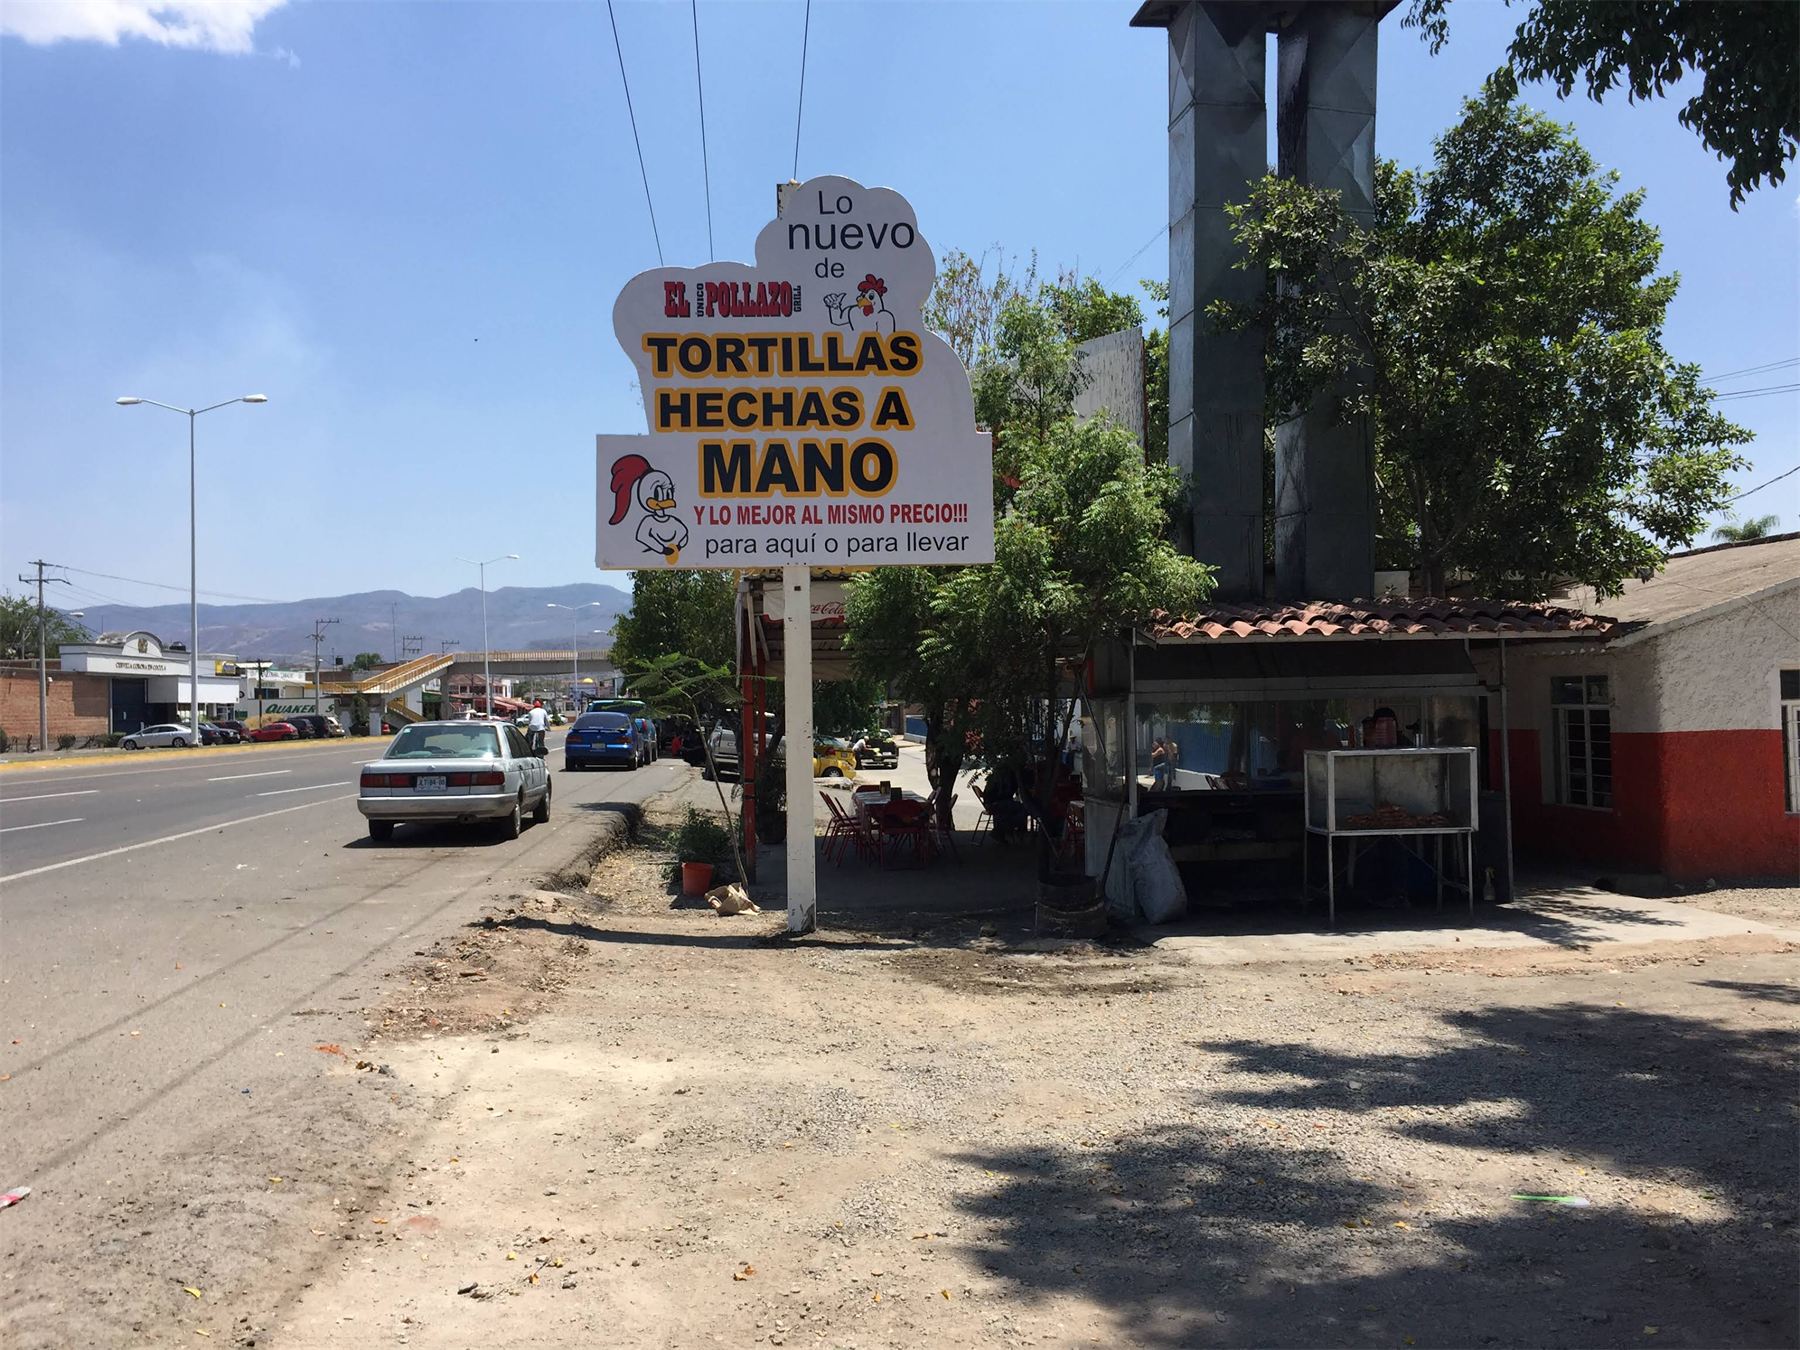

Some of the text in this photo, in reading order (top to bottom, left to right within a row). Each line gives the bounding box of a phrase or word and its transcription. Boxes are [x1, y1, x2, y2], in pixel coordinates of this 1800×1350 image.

[818, 191, 853, 215] Lo
[788, 222, 915, 250] nuevo
[815, 258, 845, 278] de
[664, 281, 691, 317] EL
[705, 281, 793, 318] POLLAZO
[645, 335, 920, 373] TORTILLAS
[658, 390, 910, 428] HECHAS A
[702, 441, 894, 494] MANO
[694, 503, 969, 525] Y LO MEJOR AL MISMO PRECIO!!!
[705, 531, 969, 559] para aquí o para llevar
[265, 703, 316, 714] QUAKER
